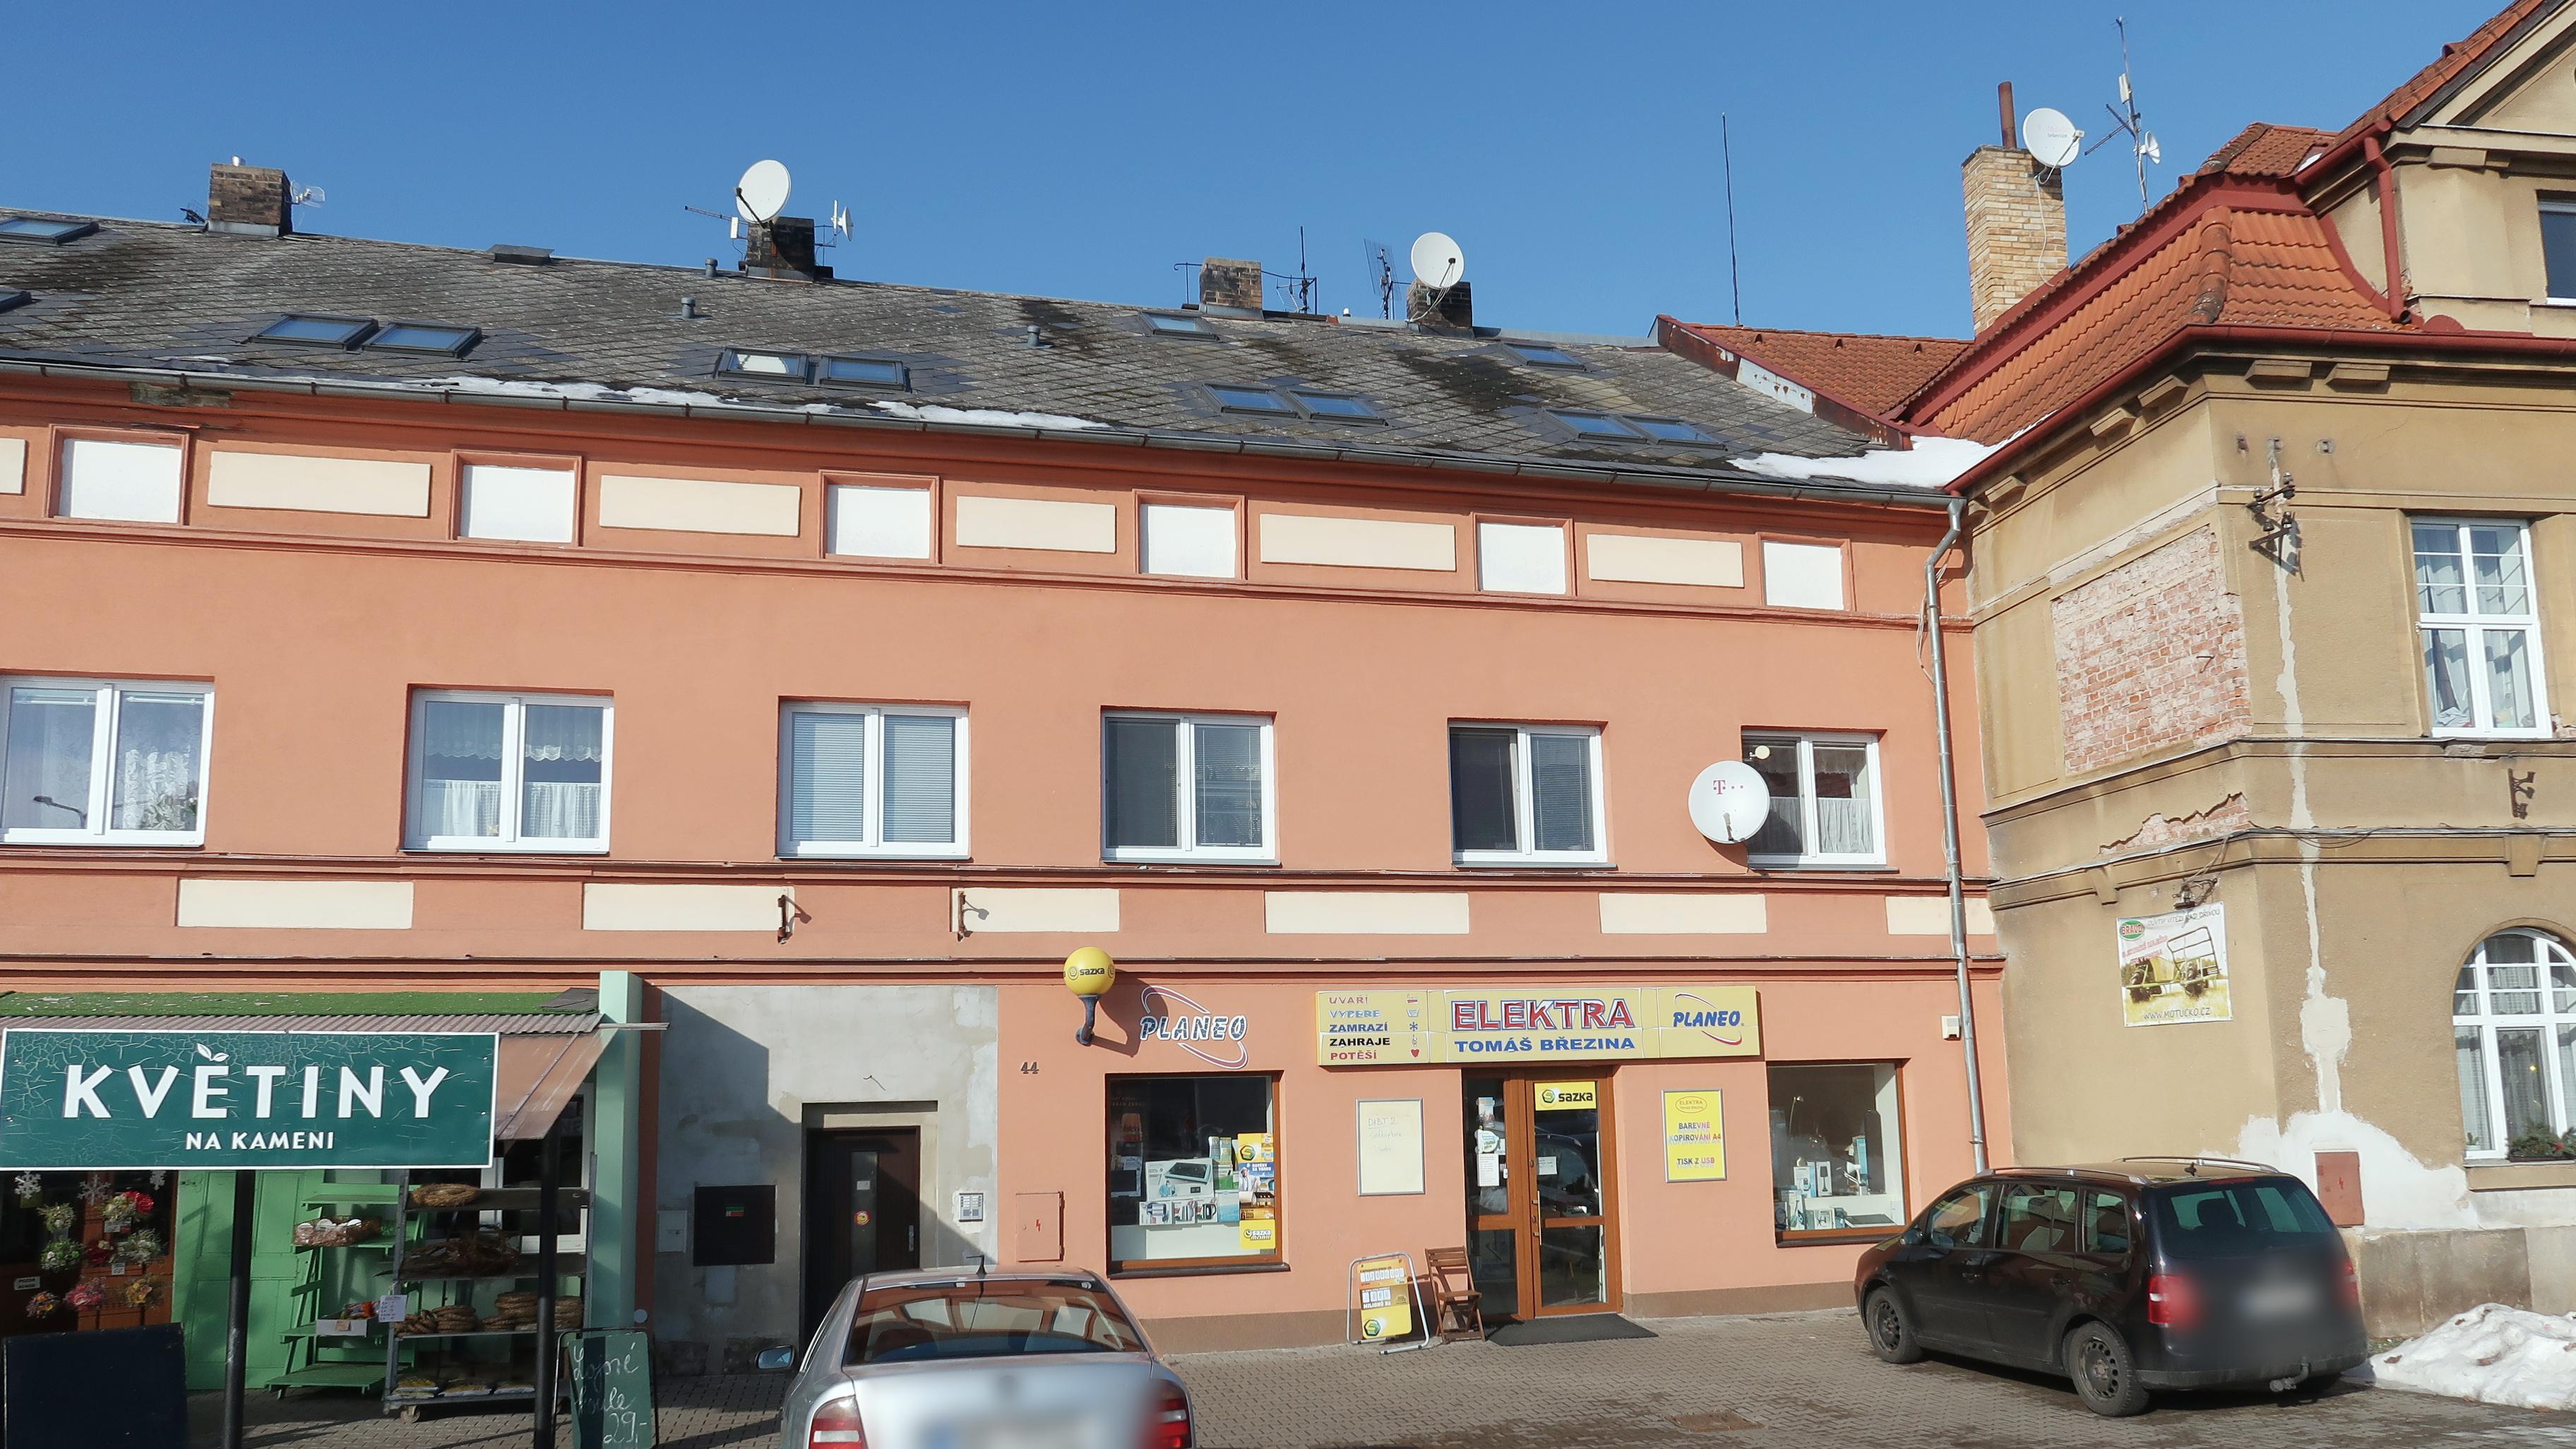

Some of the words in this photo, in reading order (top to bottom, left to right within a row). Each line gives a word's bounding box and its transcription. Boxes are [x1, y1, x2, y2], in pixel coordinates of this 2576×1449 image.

[2121, 922, 2143, 935] BRAVO
[1329, 994, 1369, 1004] UVAŘÍ
[1329, 1010, 1381, 1018] VYPERE
[1451, 998, 1635, 1031] ELEKTRA
[1673, 1010, 1741, 1027] PLANEO
[1139, 1015, 1248, 1041] PLANEO
[1329, 1022, 1388, 1032] ZAMRAZÍ
[1329, 1037, 1391, 1046] ZAHRAJE
[1455, 1037, 1532, 1052] TOMÁŠ
[1540, 1037, 1635, 1051] BŘEZINA
[1330, 1049, 1378, 1060] POTĚŠÍ
[1020, 1061, 1039, 1074] 44
[64, 1045, 451, 1119] KVĚTINY
[1558, 1092, 1593, 1102] sazka
[1678, 1121, 1710, 1130] BAREVNÉ
[186, 1133, 221, 1150] NA
[232, 1132, 333, 1150] KAMENI
